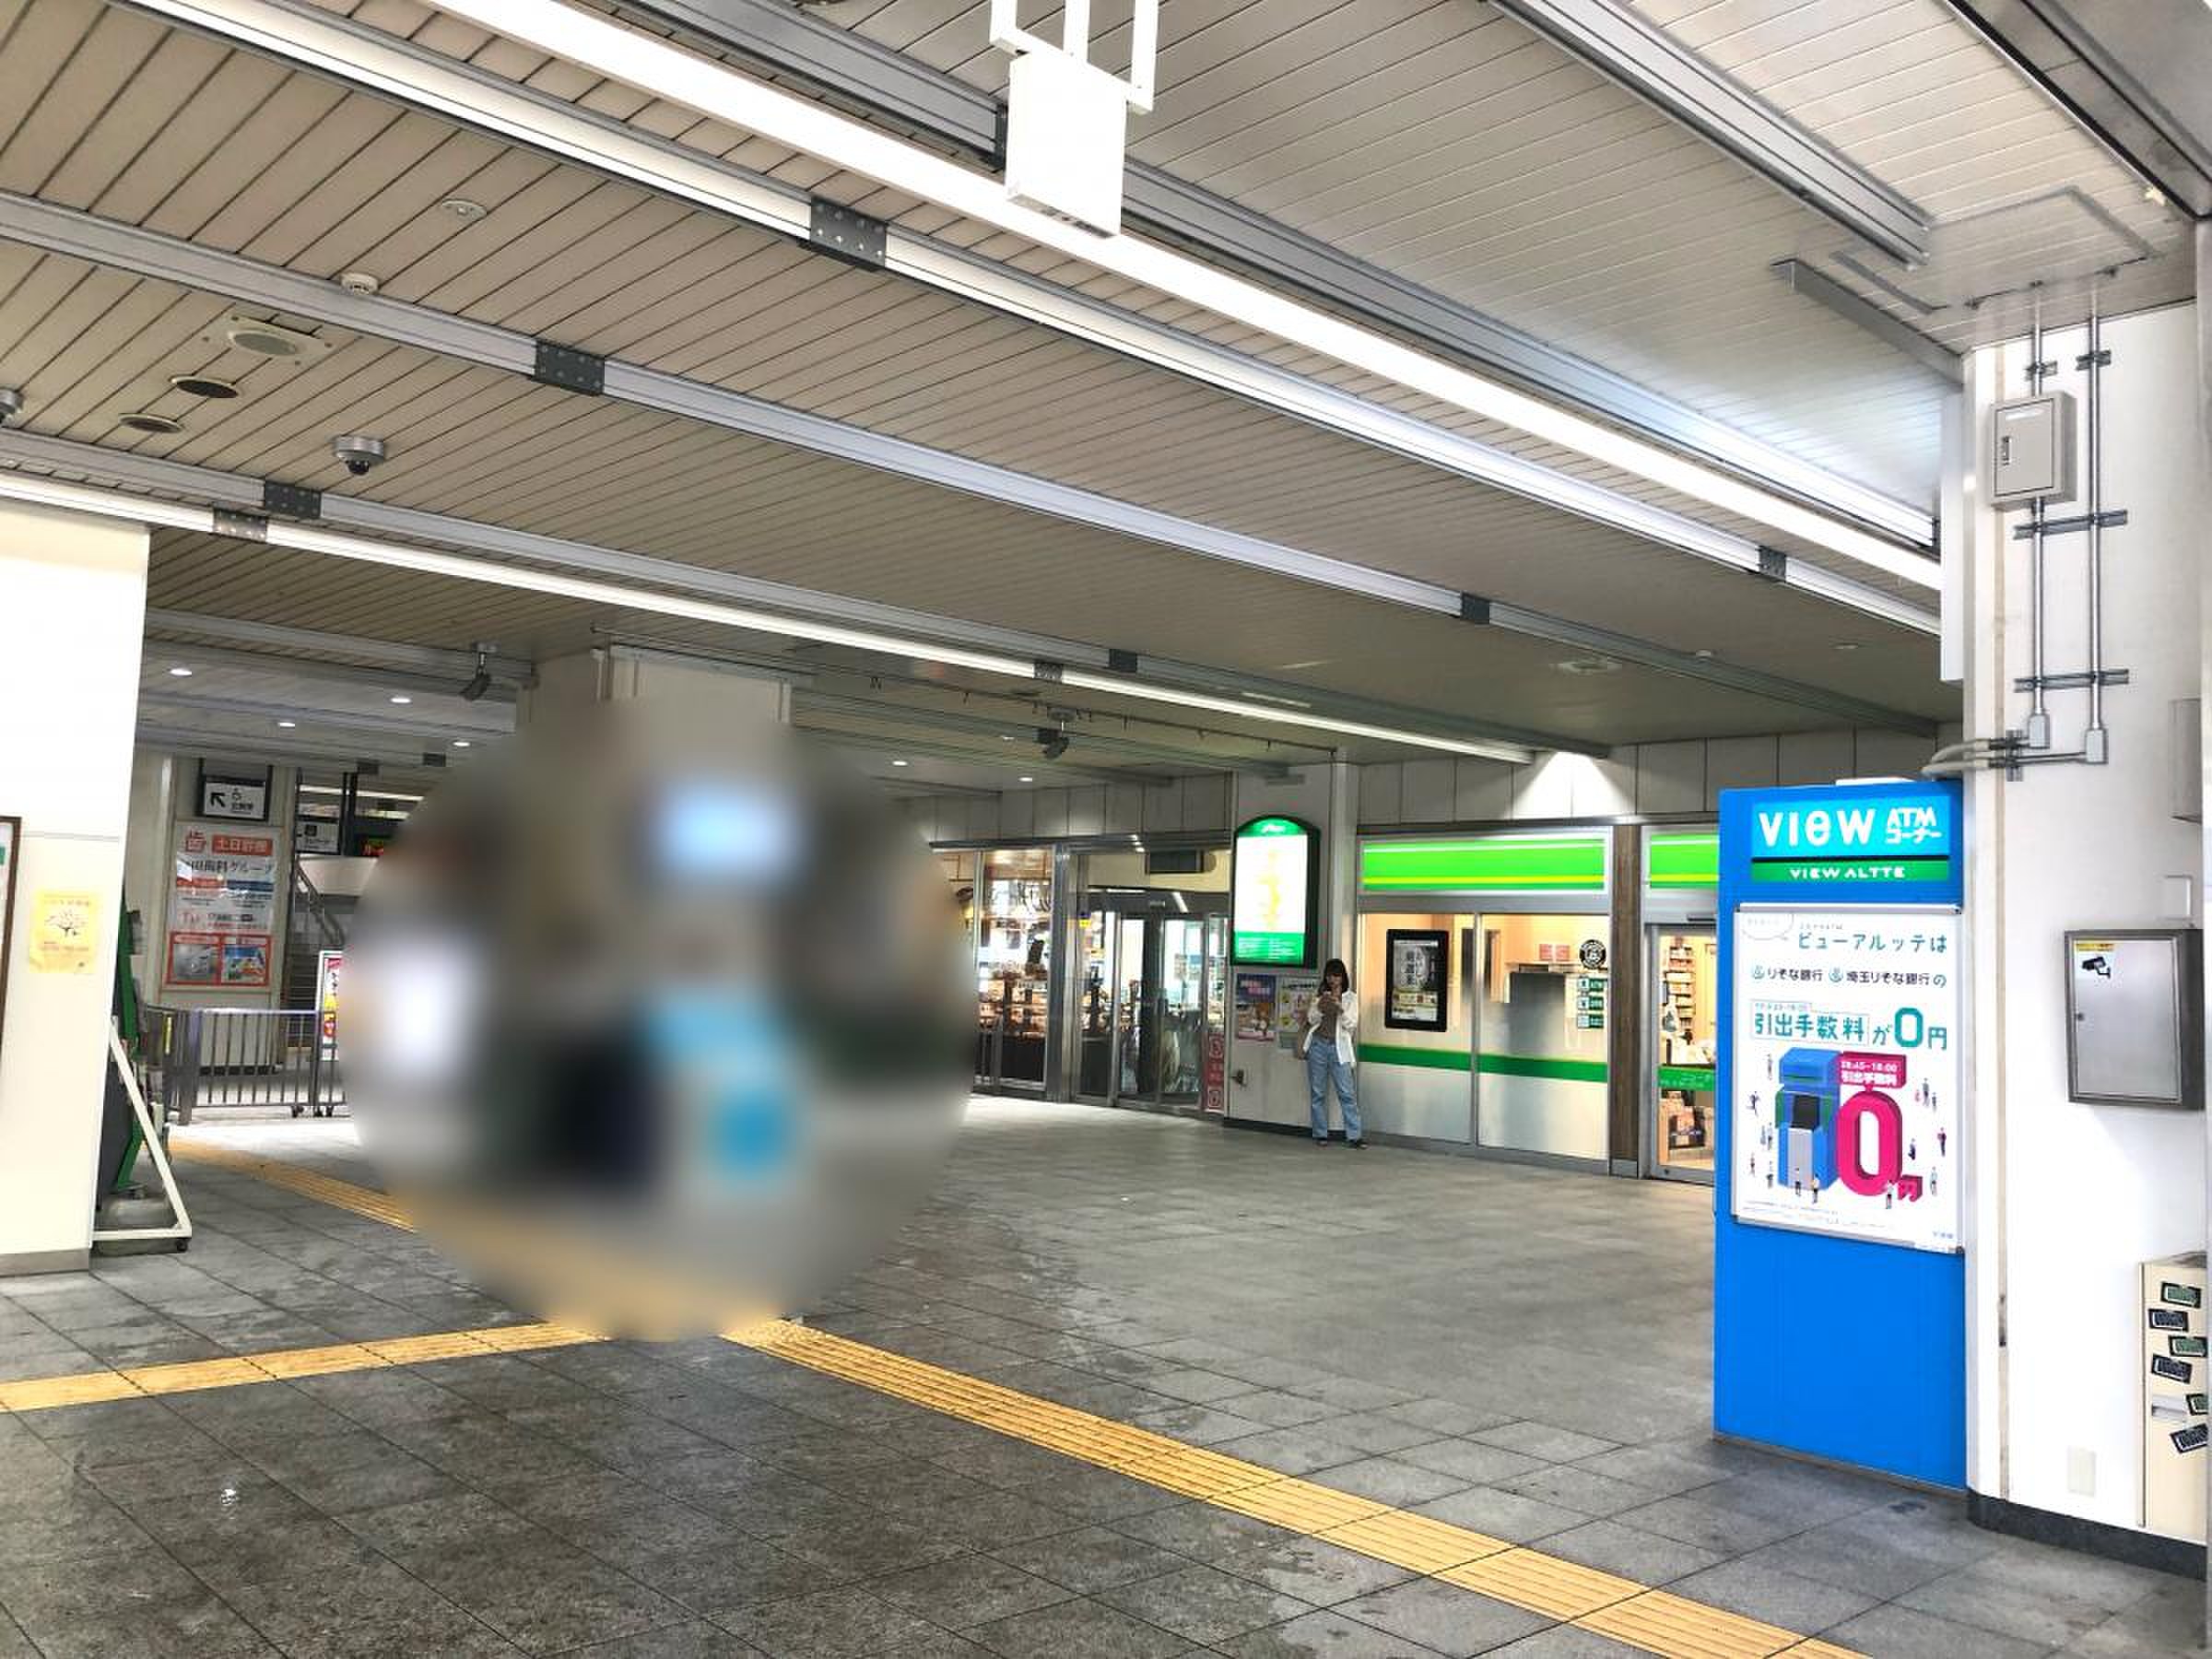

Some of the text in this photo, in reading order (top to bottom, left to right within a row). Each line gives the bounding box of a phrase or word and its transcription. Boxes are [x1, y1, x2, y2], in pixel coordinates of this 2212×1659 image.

[1888, 806, 1936, 827] ATM
[1887, 828, 1942, 844] コーナー
[1844, 866, 1905, 878] ALTTE
[1799, 931, 1947, 953] ビューアルッテは
[1767, 968, 1824, 982] りそな銀行
